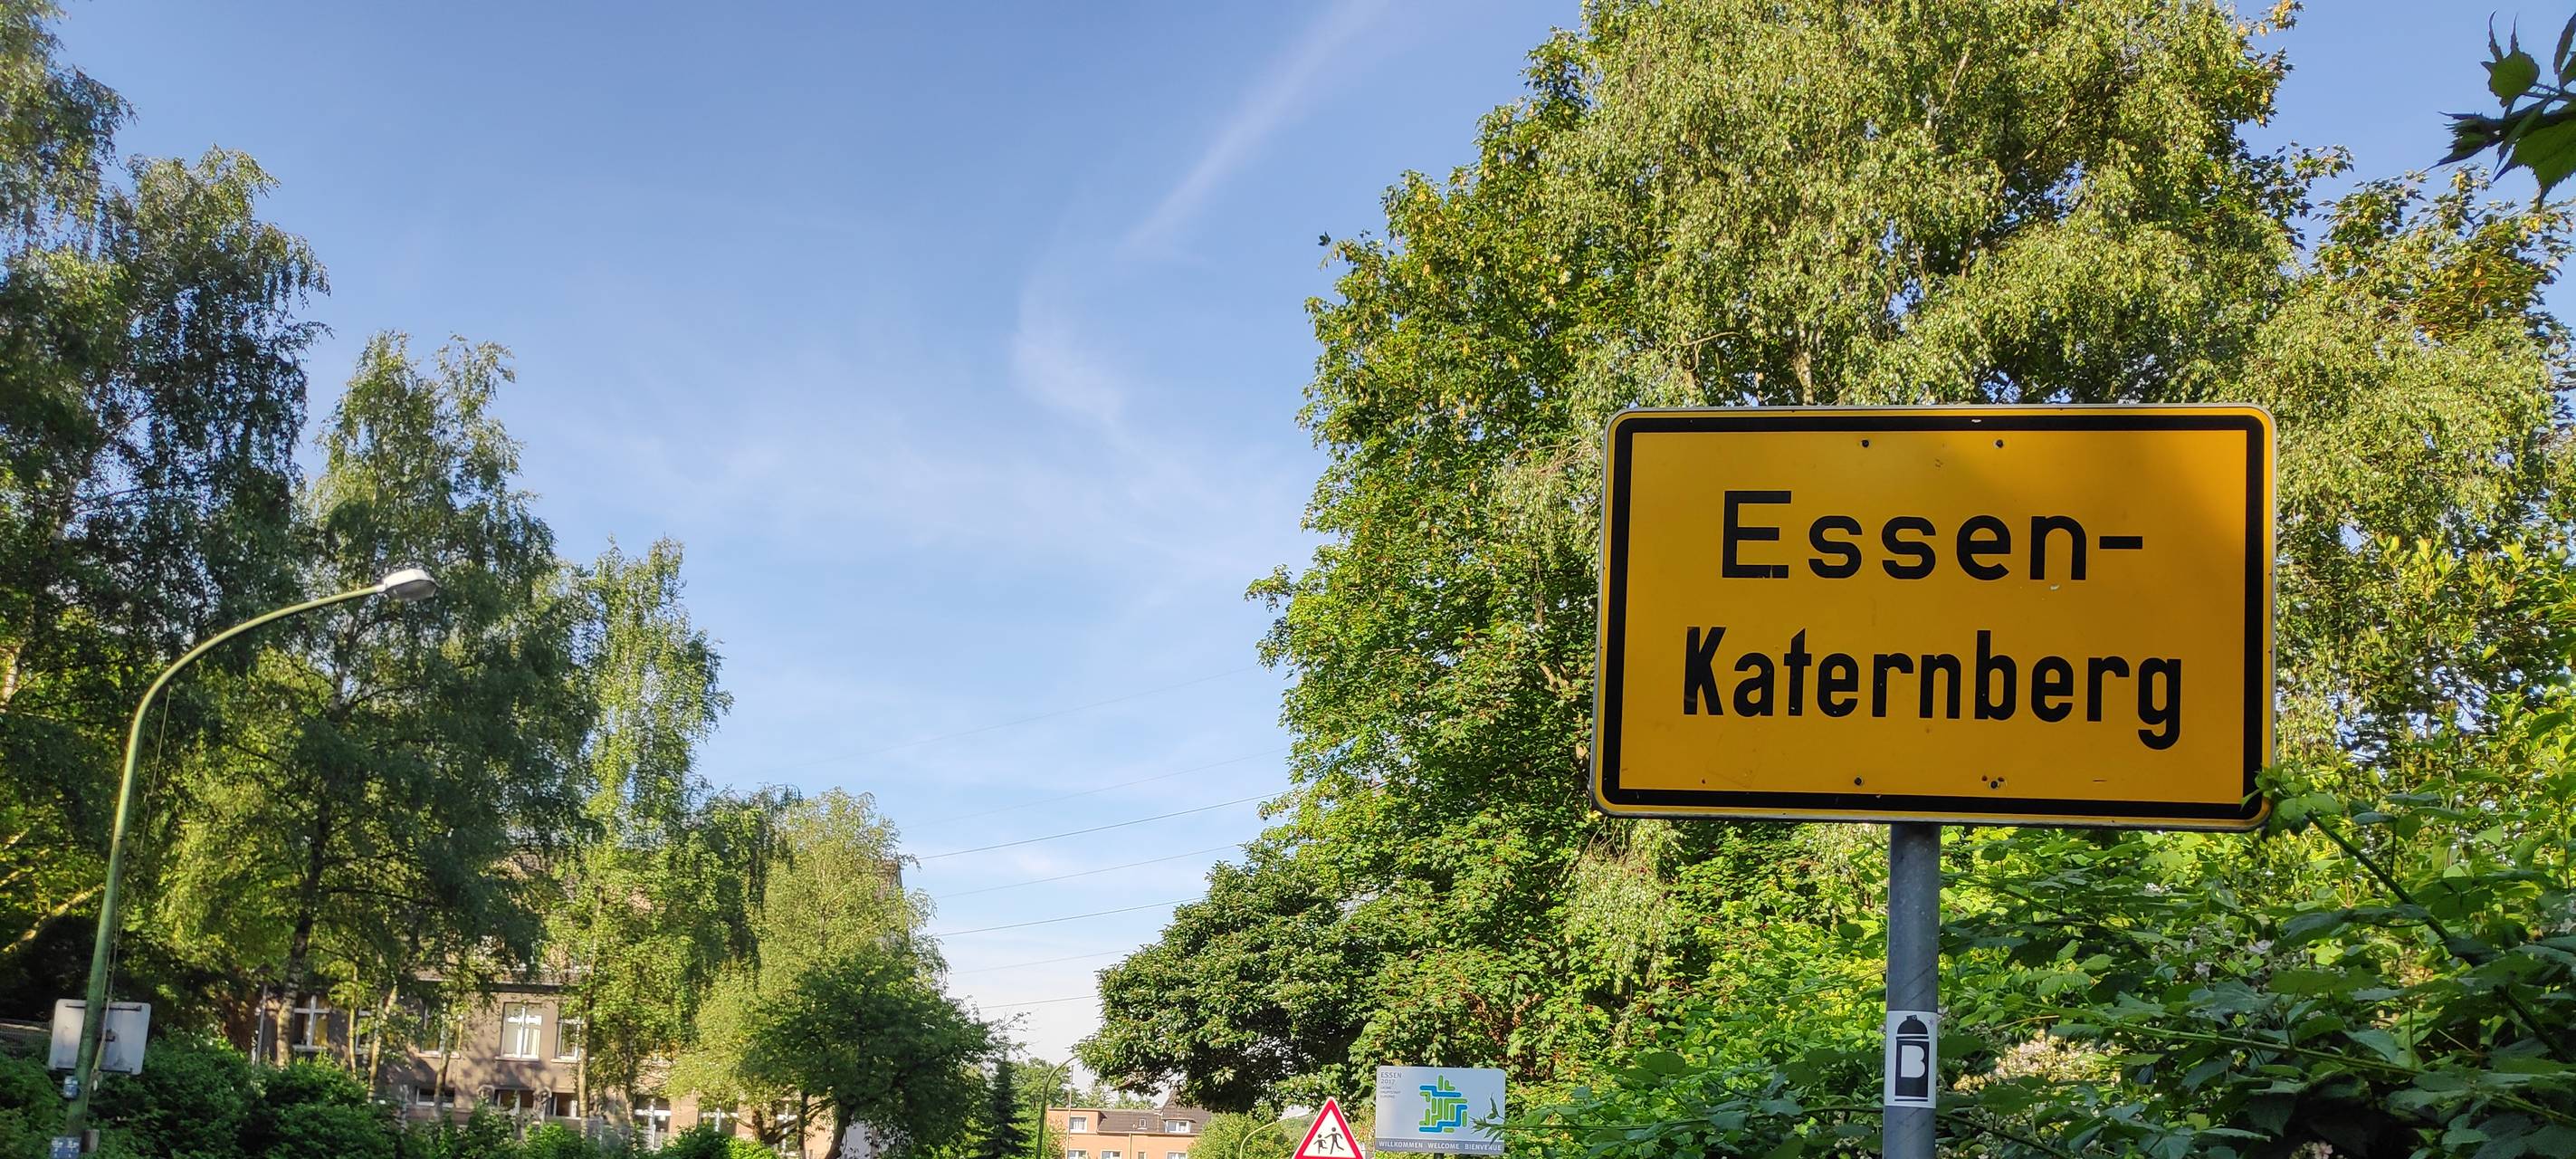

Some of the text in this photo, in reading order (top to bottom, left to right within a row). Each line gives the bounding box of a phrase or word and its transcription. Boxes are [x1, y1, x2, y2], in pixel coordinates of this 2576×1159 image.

[1721, 490, 2143, 581] Essen-
[1683, 626, 2182, 751] Katernberg
[1379, 1141, 1502, 1151] WILLKOMMEN WELCOME BIENVENUE
